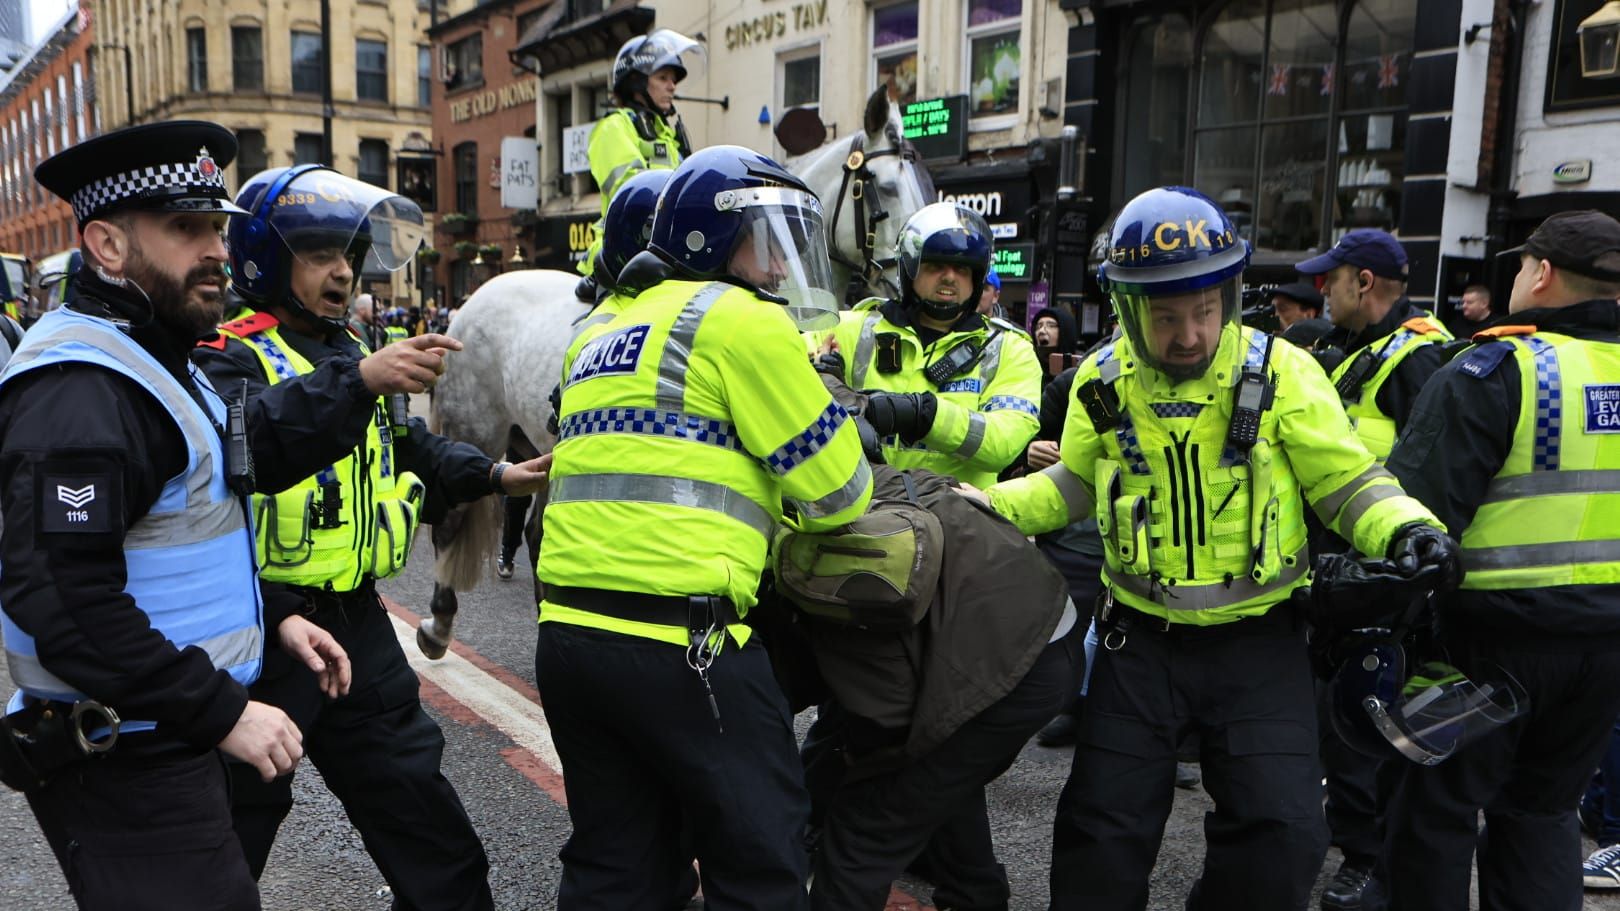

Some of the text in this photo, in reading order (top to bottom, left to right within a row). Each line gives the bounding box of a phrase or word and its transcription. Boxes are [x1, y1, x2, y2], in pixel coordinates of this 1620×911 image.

[726, 12, 785, 50] CIRCUS
[450, 98, 470, 123] THE
[472, 91, 496, 116] OLD
[511, 159, 530, 173] FAT
[1154, 218, 1212, 251] CK
[945, 380, 976, 392] POLICE
[66, 510, 89, 522] 1116
